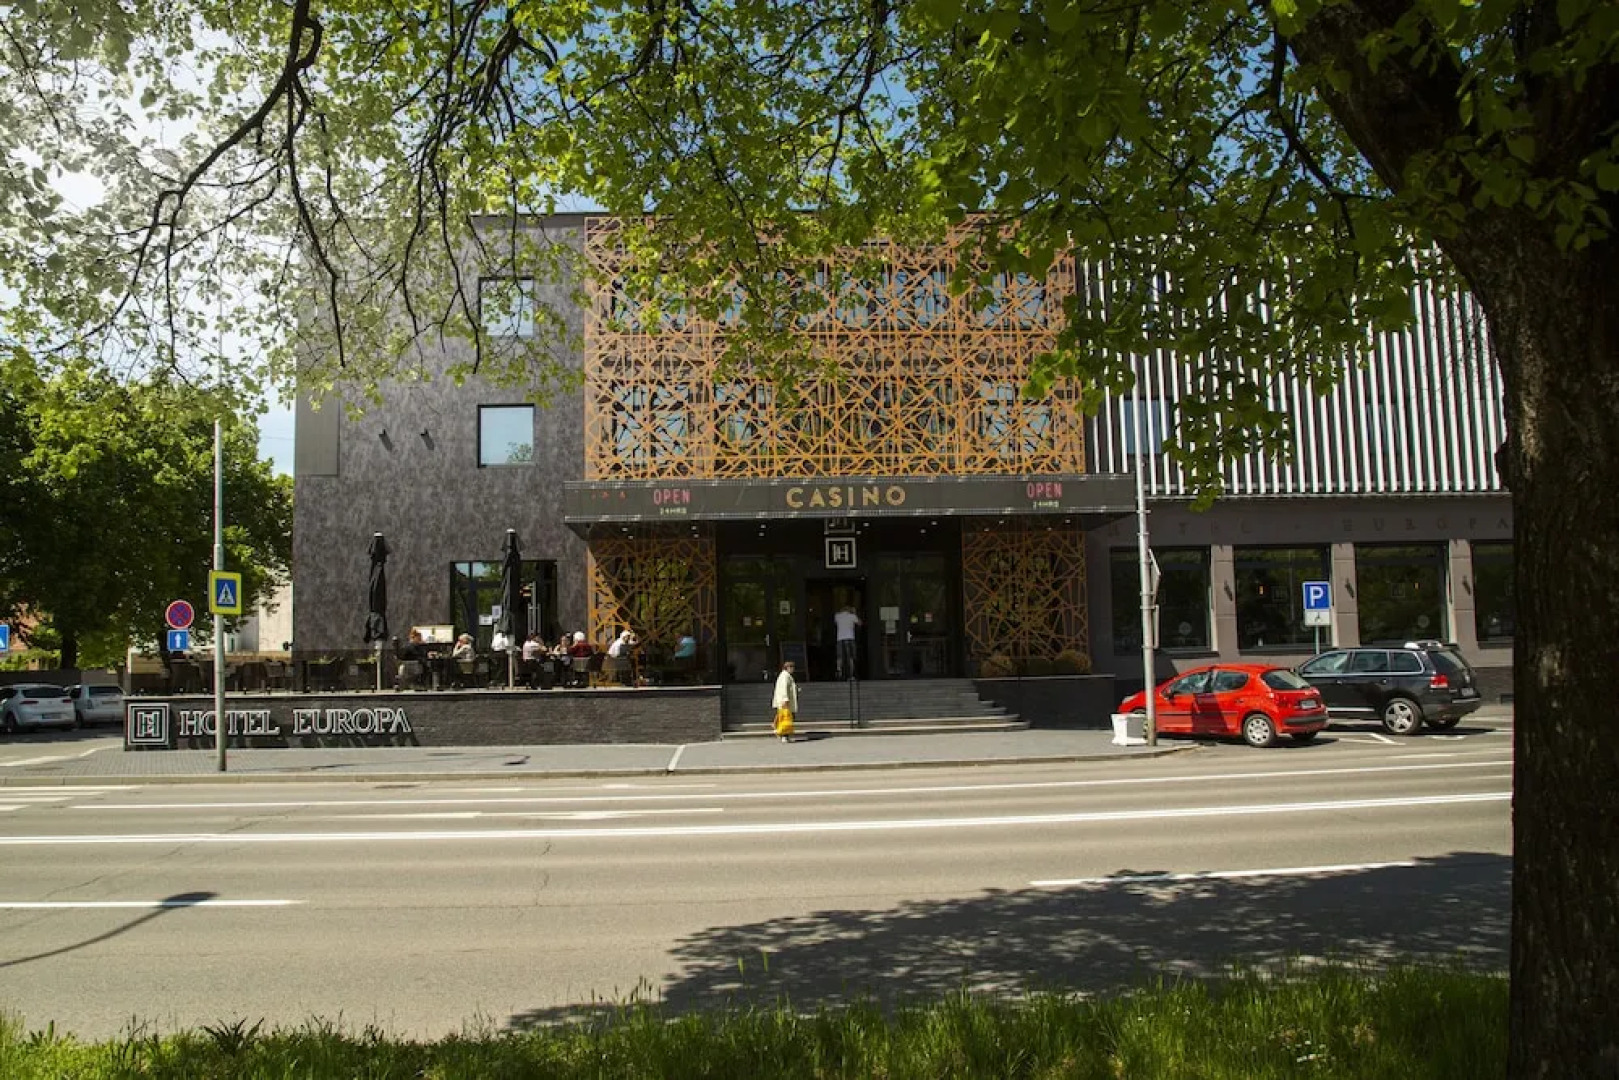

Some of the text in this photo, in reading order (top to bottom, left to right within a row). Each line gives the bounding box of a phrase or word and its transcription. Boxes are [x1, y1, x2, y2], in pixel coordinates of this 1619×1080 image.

[653, 488, 691, 505] OPEN
[786, 485, 906, 508] CASINO
[1026, 481, 1063, 498] OPEN
[1309, 585, 1324, 607] P
[179, 707, 412, 736] HOTEL EUROPA
